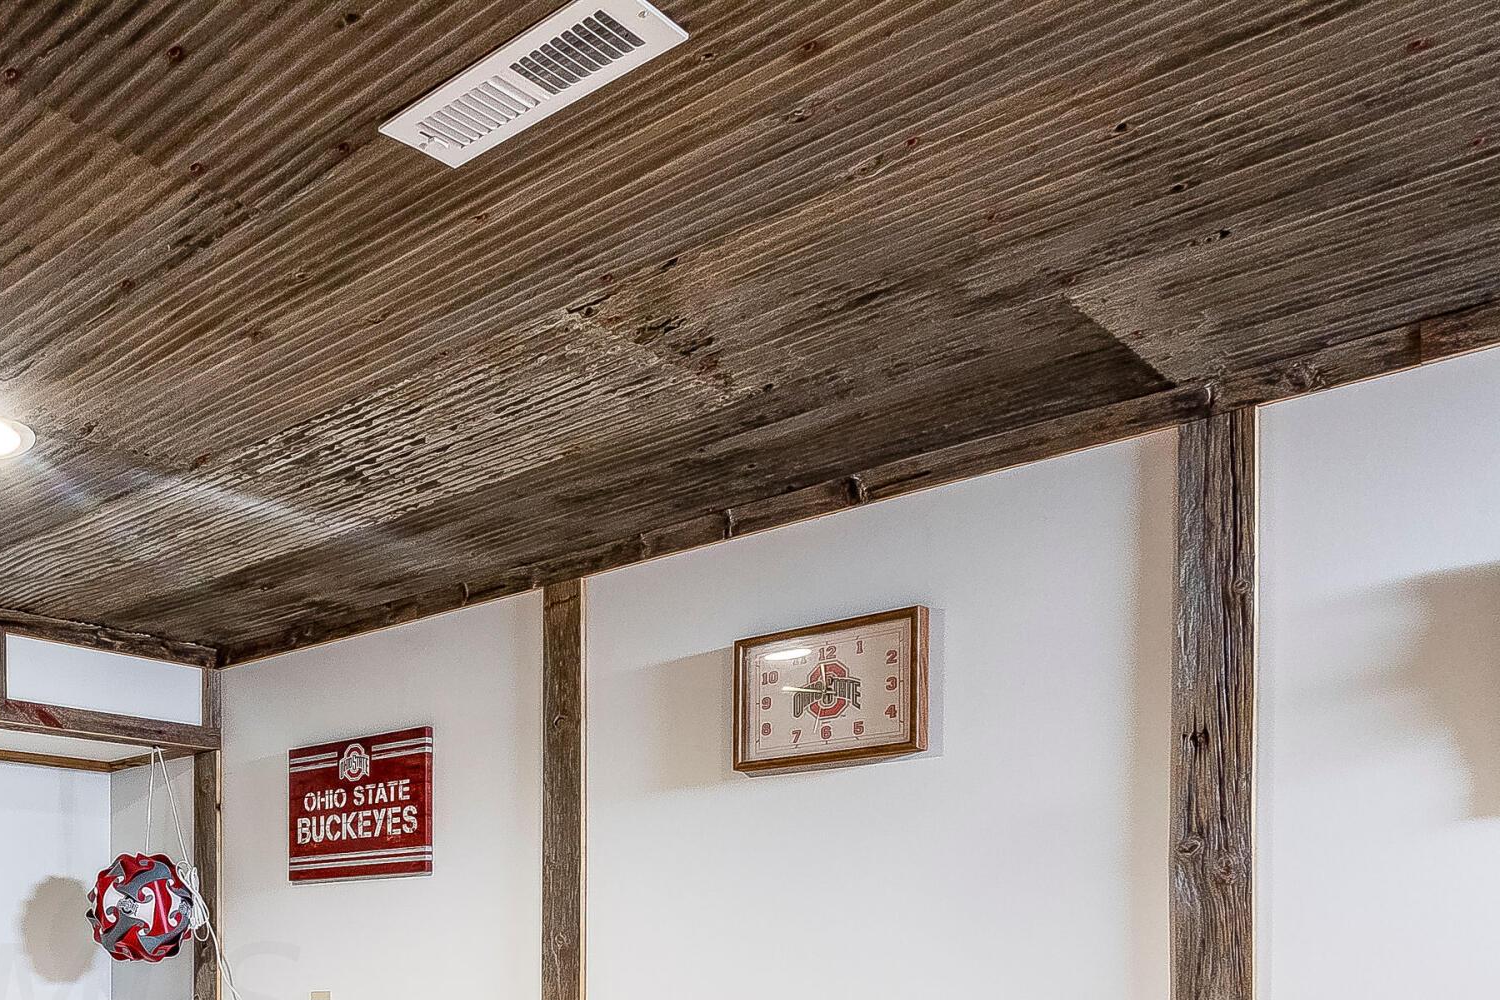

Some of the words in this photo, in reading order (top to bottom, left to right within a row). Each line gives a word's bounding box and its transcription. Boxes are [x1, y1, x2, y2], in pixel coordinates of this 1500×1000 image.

[818, 645, 837, 661] 12
[856, 640, 864, 654] 1
[886, 650, 898, 665] 2
[761, 671, 779, 686] 10
[885, 676, 898, 691] 3
[761, 696, 772, 710] 9
[884, 704, 898, 719] 4
[761, 722, 772, 736] 8
[820, 725, 832, 740] 6
[853, 720, 865, 735] 5
[791, 729, 802, 744] 7
[303, 788, 347, 812] OHIO
[353, 779, 411, 806] STATE
[297, 805, 418, 845] BUCKEYES
